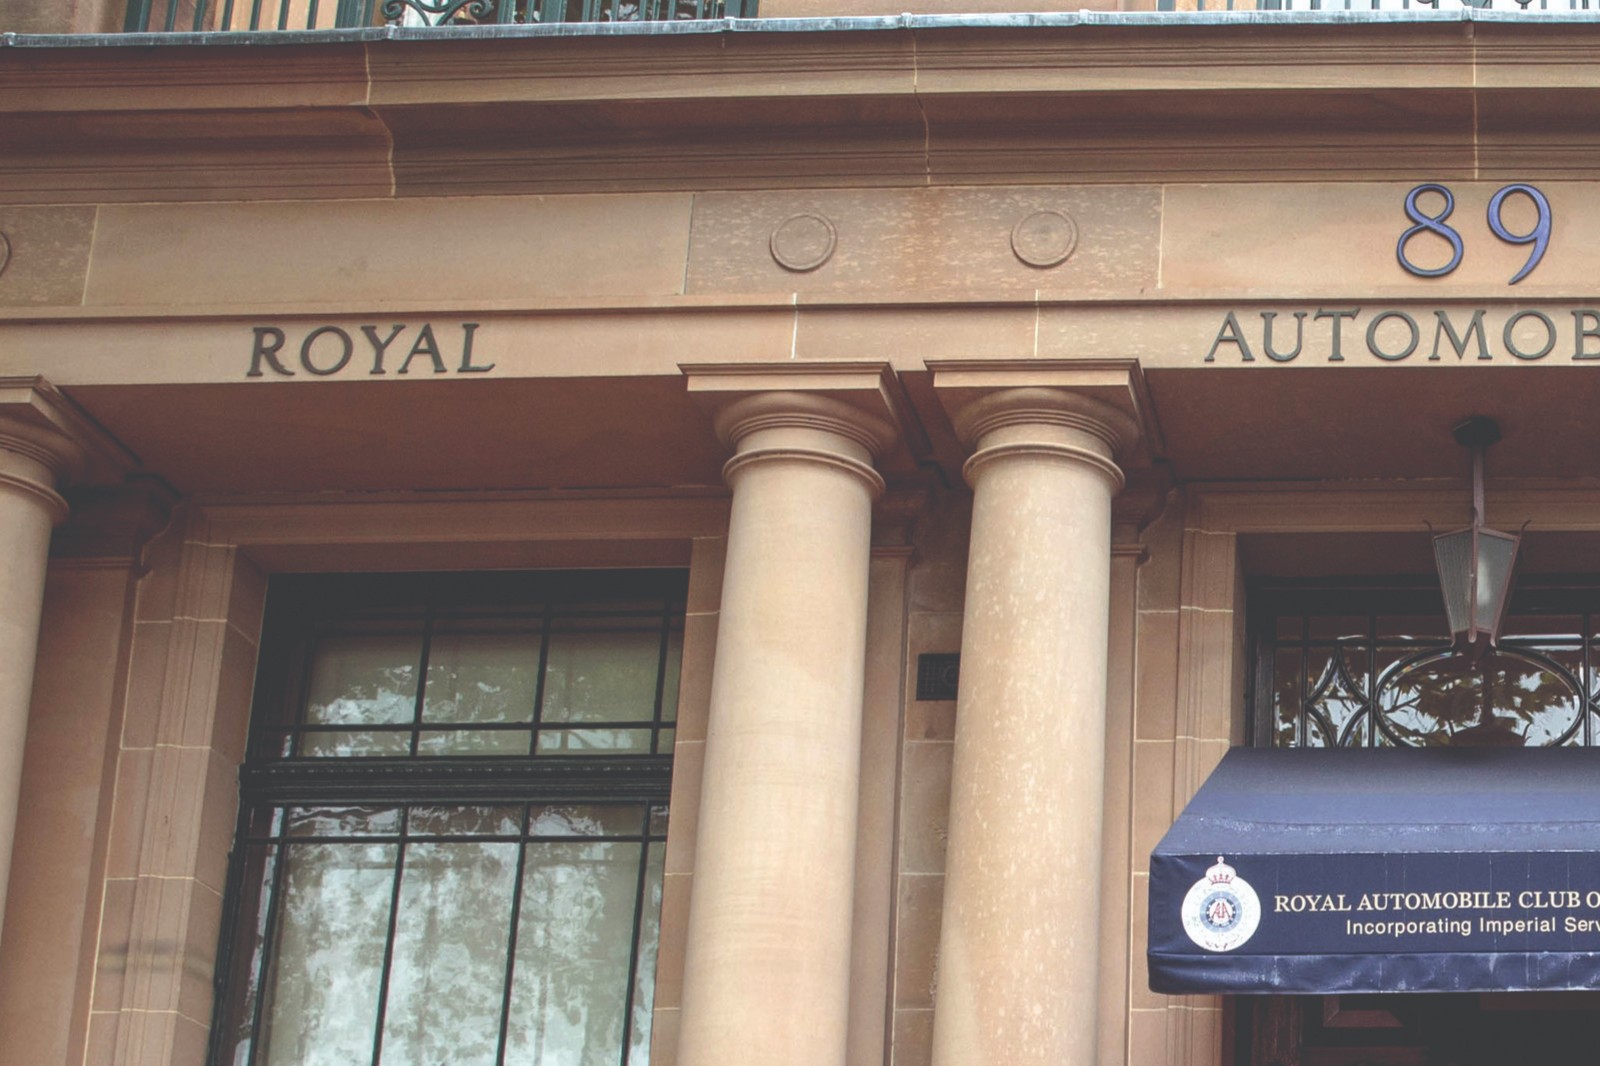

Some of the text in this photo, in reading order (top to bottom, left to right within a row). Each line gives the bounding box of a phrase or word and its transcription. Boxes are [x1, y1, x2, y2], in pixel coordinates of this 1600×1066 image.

[1397, 184, 1552, 285] 89
[246, 323, 496, 377] ROYAL
[1274, 894, 1351, 912] ROYAL
[1356, 892, 1511, 911] AUTOMOBILE
[1518, 891, 1580, 908] CLUB
[1347, 918, 1472, 937] Incorporating
[1480, 917, 1556, 935] Imperial
